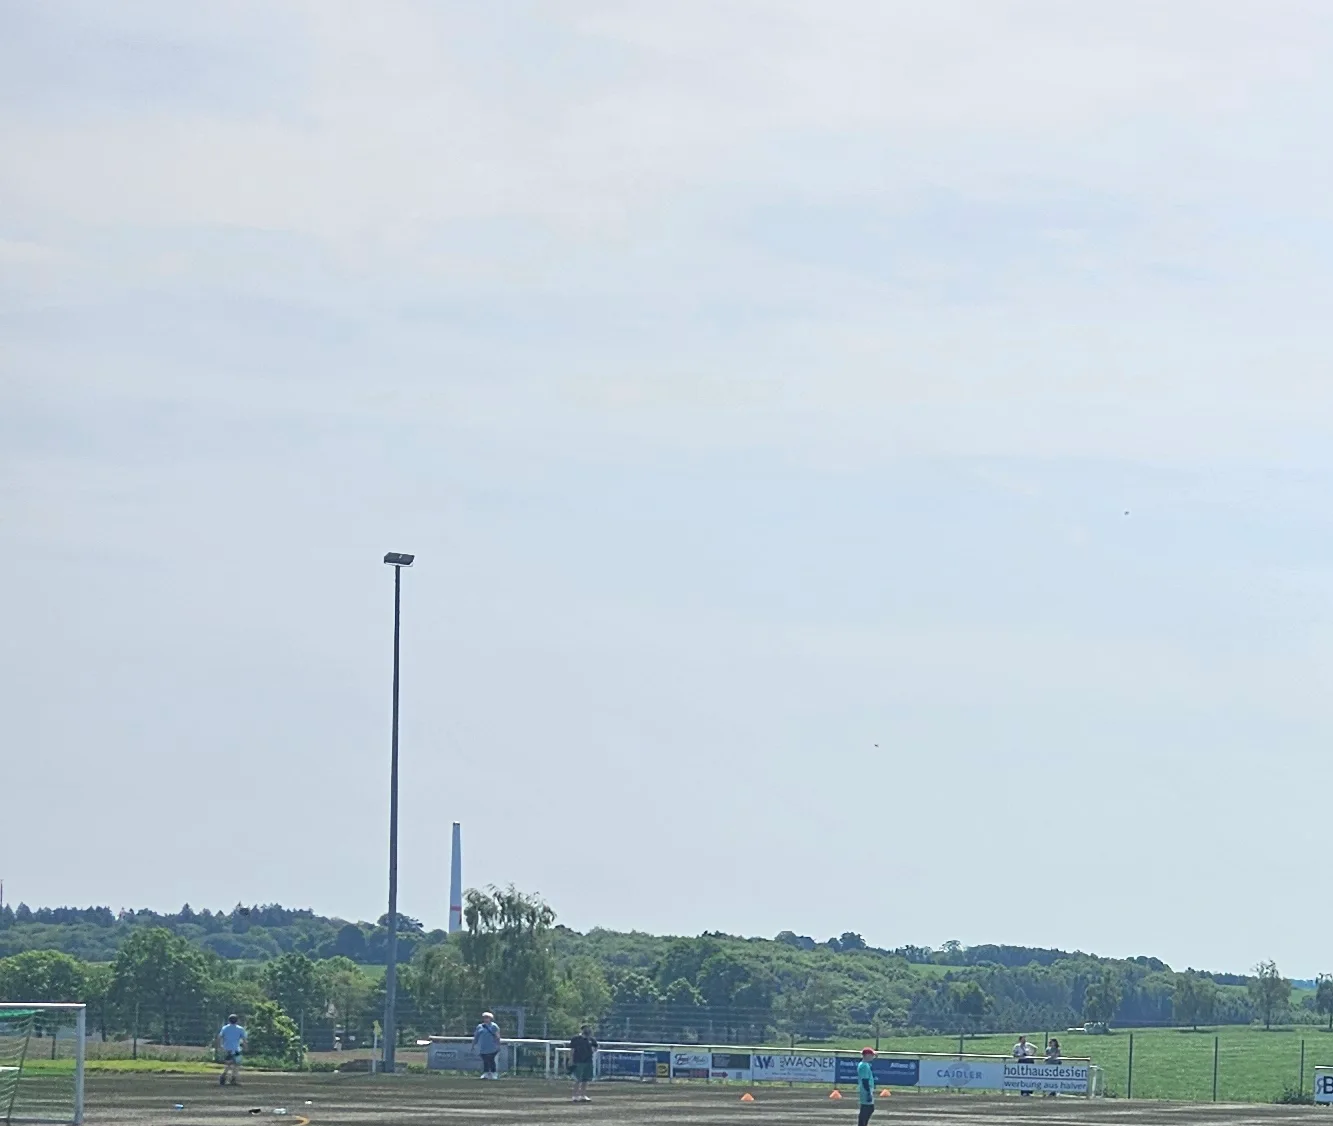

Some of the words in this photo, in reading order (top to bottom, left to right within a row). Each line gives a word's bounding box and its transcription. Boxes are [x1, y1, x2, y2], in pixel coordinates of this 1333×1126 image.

[784, 1056, 835, 1068] WAGNER
[1003, 1065, 1087, 1078] holthaus:design
[1003, 1080, 1042, 1090] werbung
[1043, 1081, 1058, 1090] aus
[1060, 1081, 1087, 1090] halver
